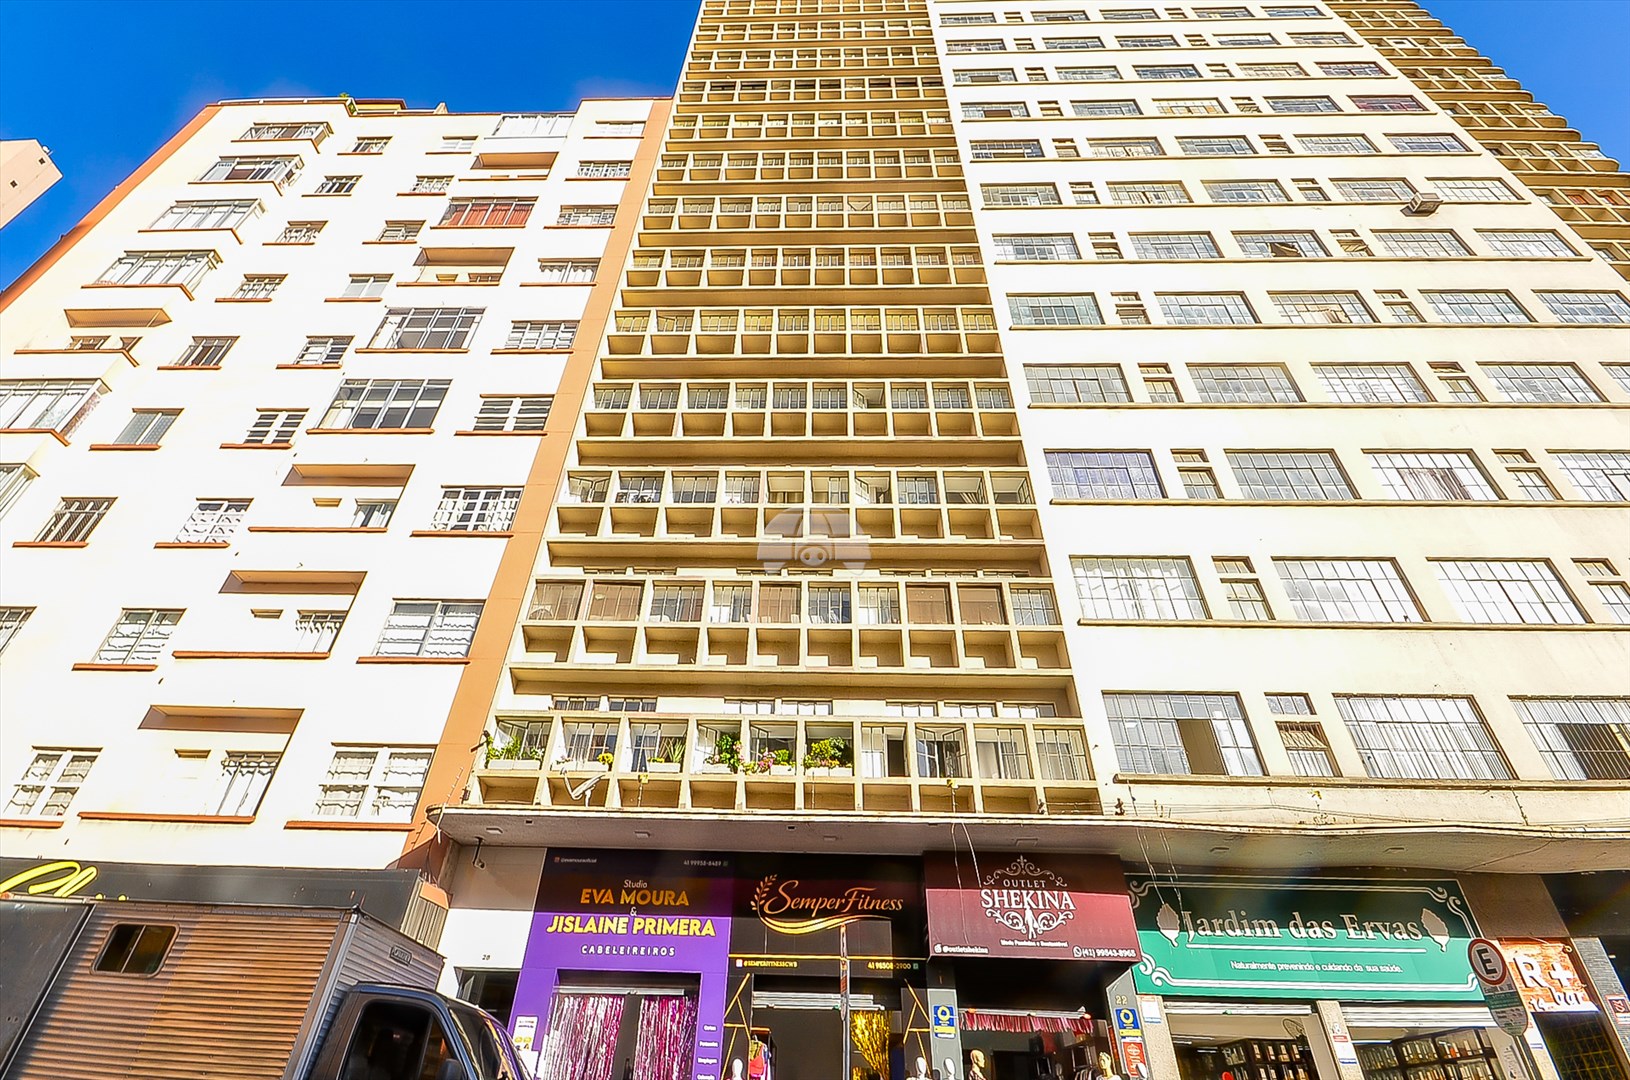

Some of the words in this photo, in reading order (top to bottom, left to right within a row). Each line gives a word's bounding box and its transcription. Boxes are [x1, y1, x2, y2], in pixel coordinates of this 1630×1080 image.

[623, 879, 647, 888] Studio
[1003, 879, 1046, 888] OUTLET
[580, 888, 614, 904] EVA
[620, 889, 689, 906] MOURA
[763, 879, 903, 917] SemperFitness
[980, 889, 1076, 910] SHEKINA
[629, 906, 638, 917] &
[546, 916, 628, 934] JISLAINE
[631, 917, 716, 937] PRIMERA
[1183, 910, 1282, 942] Jardim
[1288, 911, 1337, 940] das
[1339, 913, 1424, 941] Ervas
[581, 945, 675, 956] CABELEIREIROS
[1230, 960, 1277, 971] Naturalmente
[1277, 962, 1315, 972] prevenindo
[1322, 962, 1353, 972] cuidando
[1353, 962, 1363, 972] da
[1476, 947, 1499, 975] E
[1115, 995, 1128, 1006] 22
